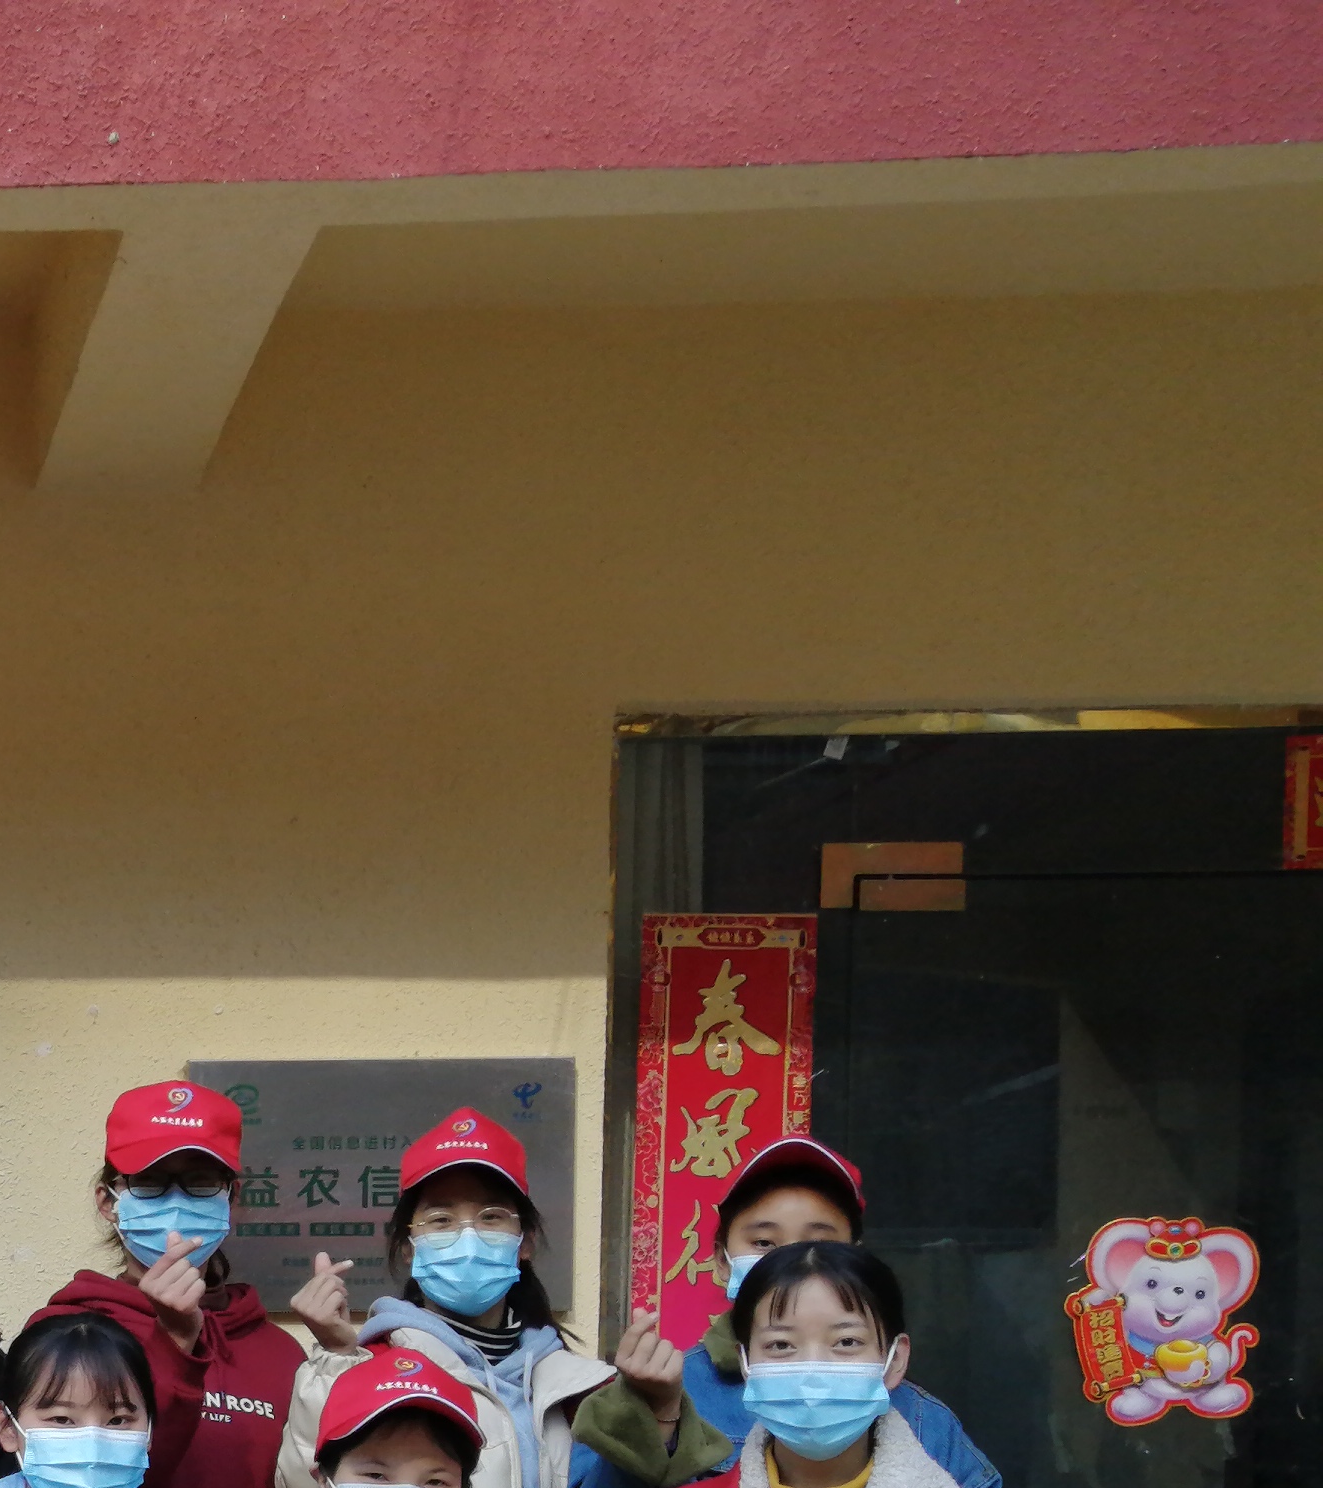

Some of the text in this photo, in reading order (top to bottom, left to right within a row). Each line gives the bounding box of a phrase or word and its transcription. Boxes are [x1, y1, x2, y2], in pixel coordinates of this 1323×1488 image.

[236, 1165, 401, 1209] 益农信
[209, 1412, 232, 1423] LIFE
[225, 1394, 275, 1420] ROSE
